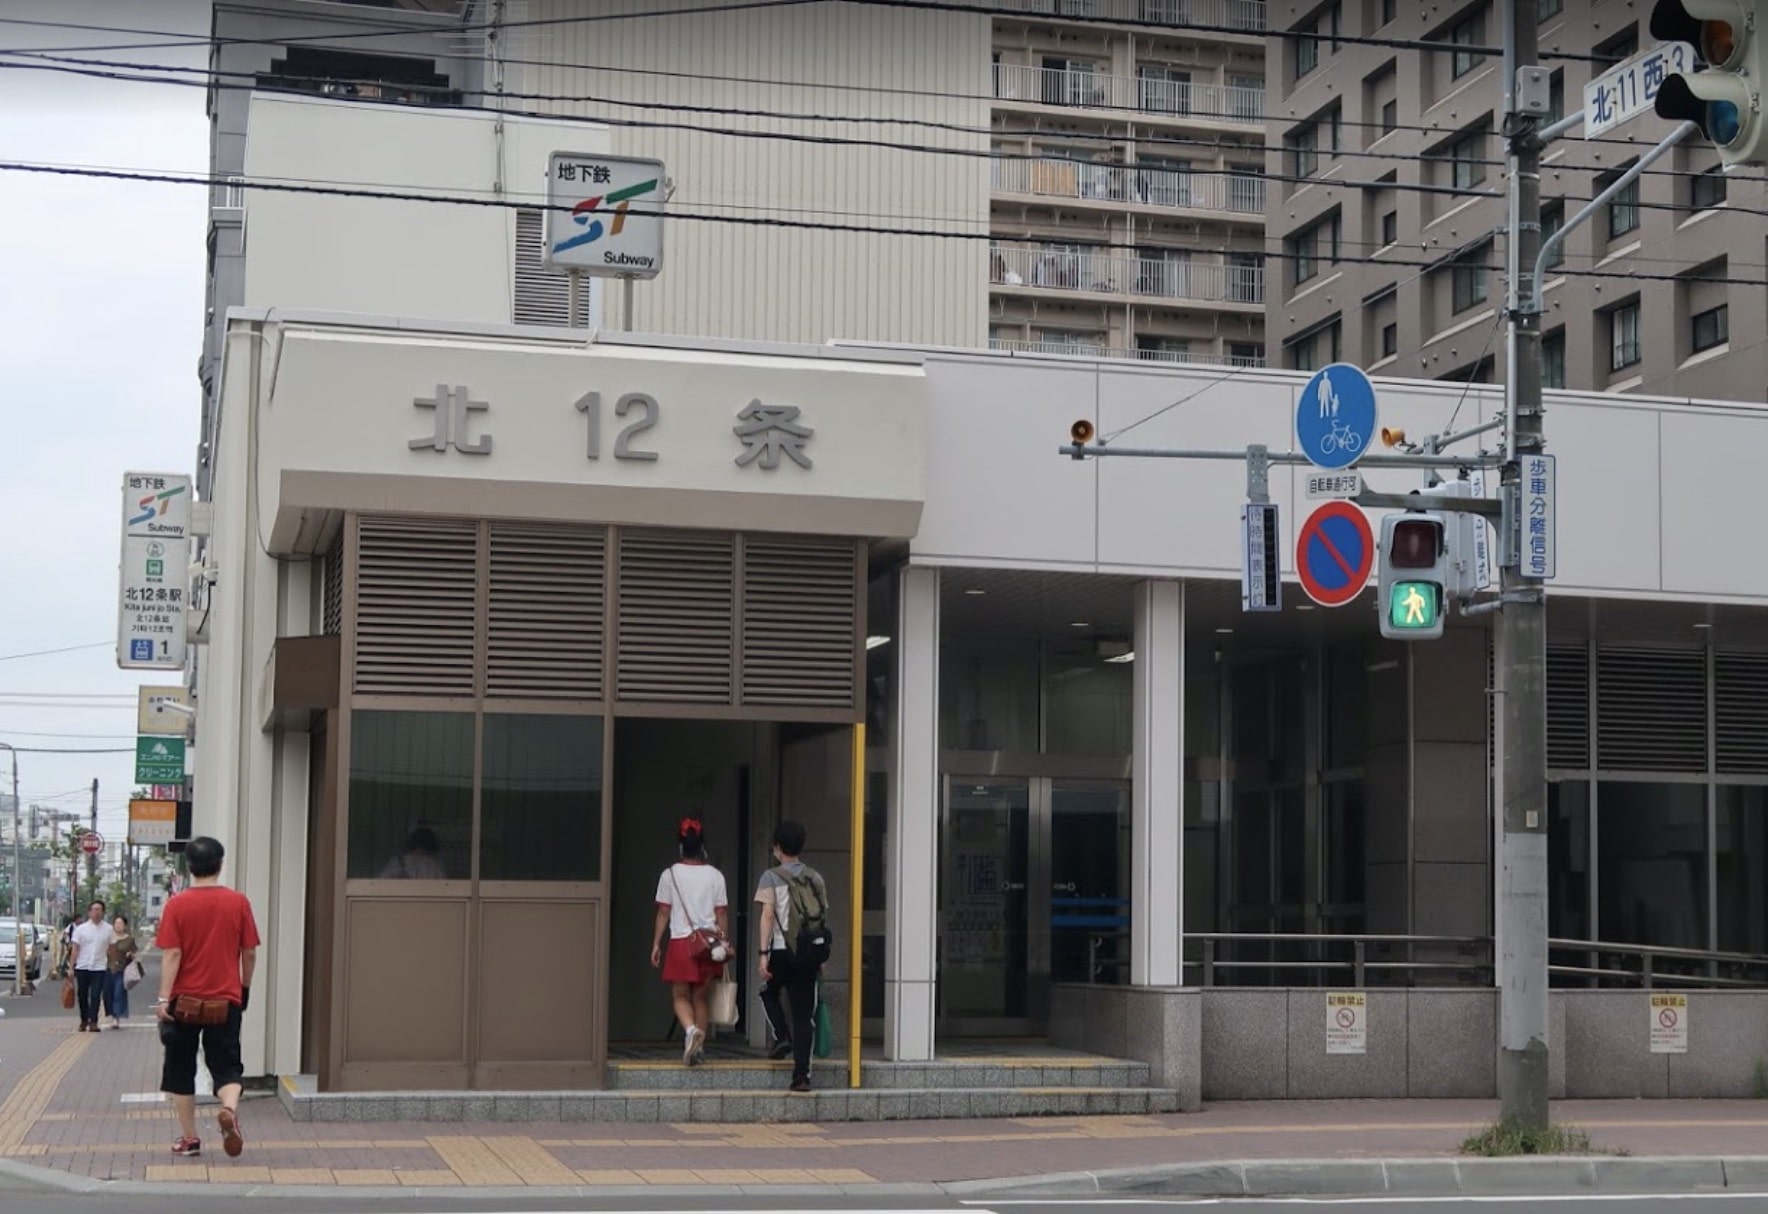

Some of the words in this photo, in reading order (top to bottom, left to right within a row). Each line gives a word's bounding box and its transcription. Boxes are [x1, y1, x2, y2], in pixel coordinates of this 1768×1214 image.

[1592, 45, 1684, 124] 北11西3
[558, 163, 611, 184] 地下鉄
[604, 251, 654, 267] Subway
[408, 383, 493, 455] 北
[574, 390, 660, 461] 12
[733, 398, 815, 470] 条
[129, 477, 165, 489] 地下鉄
[1530, 459, 1547, 574] 歩車分離信号
[148, 523, 184, 534] Subway
[126, 588, 182, 601] 北12条駅
[161, 640, 168, 655] 1
[138, 767, 182, 779] クリーニング
